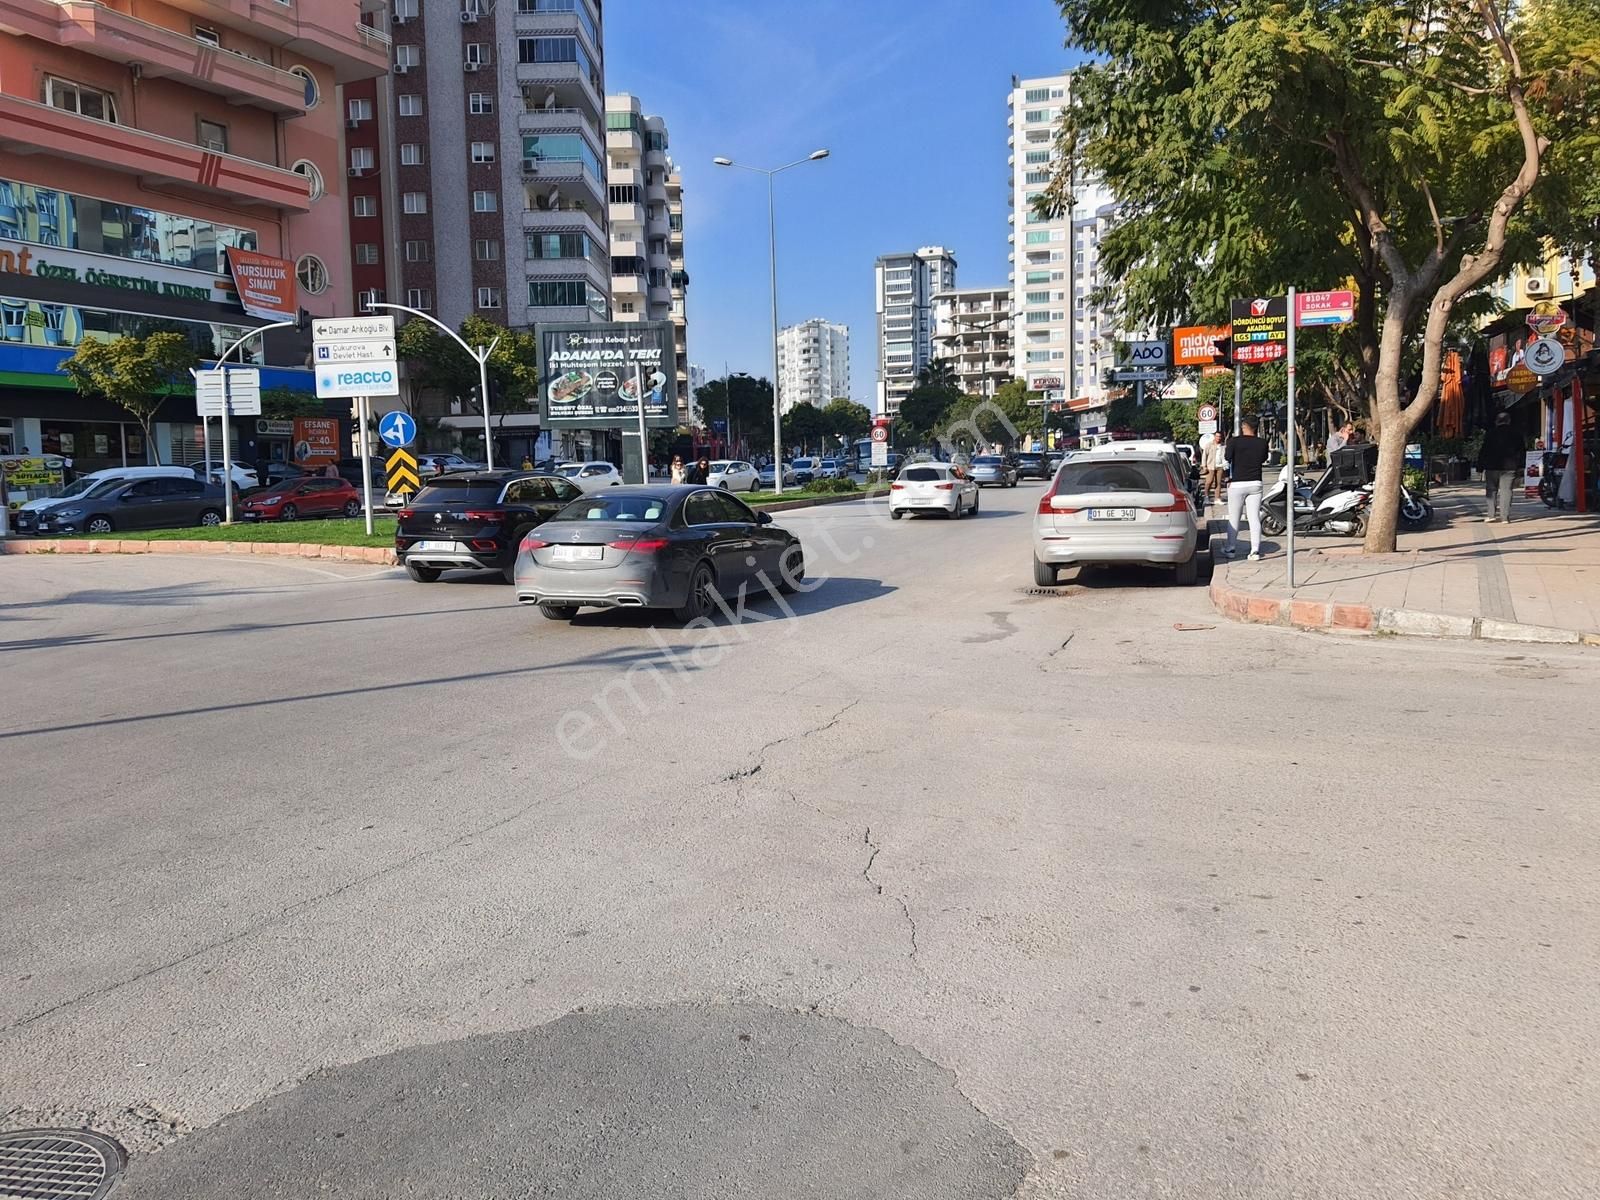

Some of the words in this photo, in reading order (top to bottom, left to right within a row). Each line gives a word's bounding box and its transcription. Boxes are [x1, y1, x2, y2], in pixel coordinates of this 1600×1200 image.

[36, 260, 81, 281] ÖZEL
[237, 264, 286, 279] BURSLULUK
[248, 278, 276, 291] SINAVI
[1305, 294, 1330, 302] 81047
[605, 336, 628, 345] Kebap
[629, 350, 661, 359] TEK!
[1132, 346, 1163, 360] ADO
[337, 370, 392, 385] reacto
[1202, 410, 1212, 418] 60
[304, 420, 330, 429] EFSANE
[1093, 510, 1101, 518] 01
[1121, 509, 1133, 517] 340
